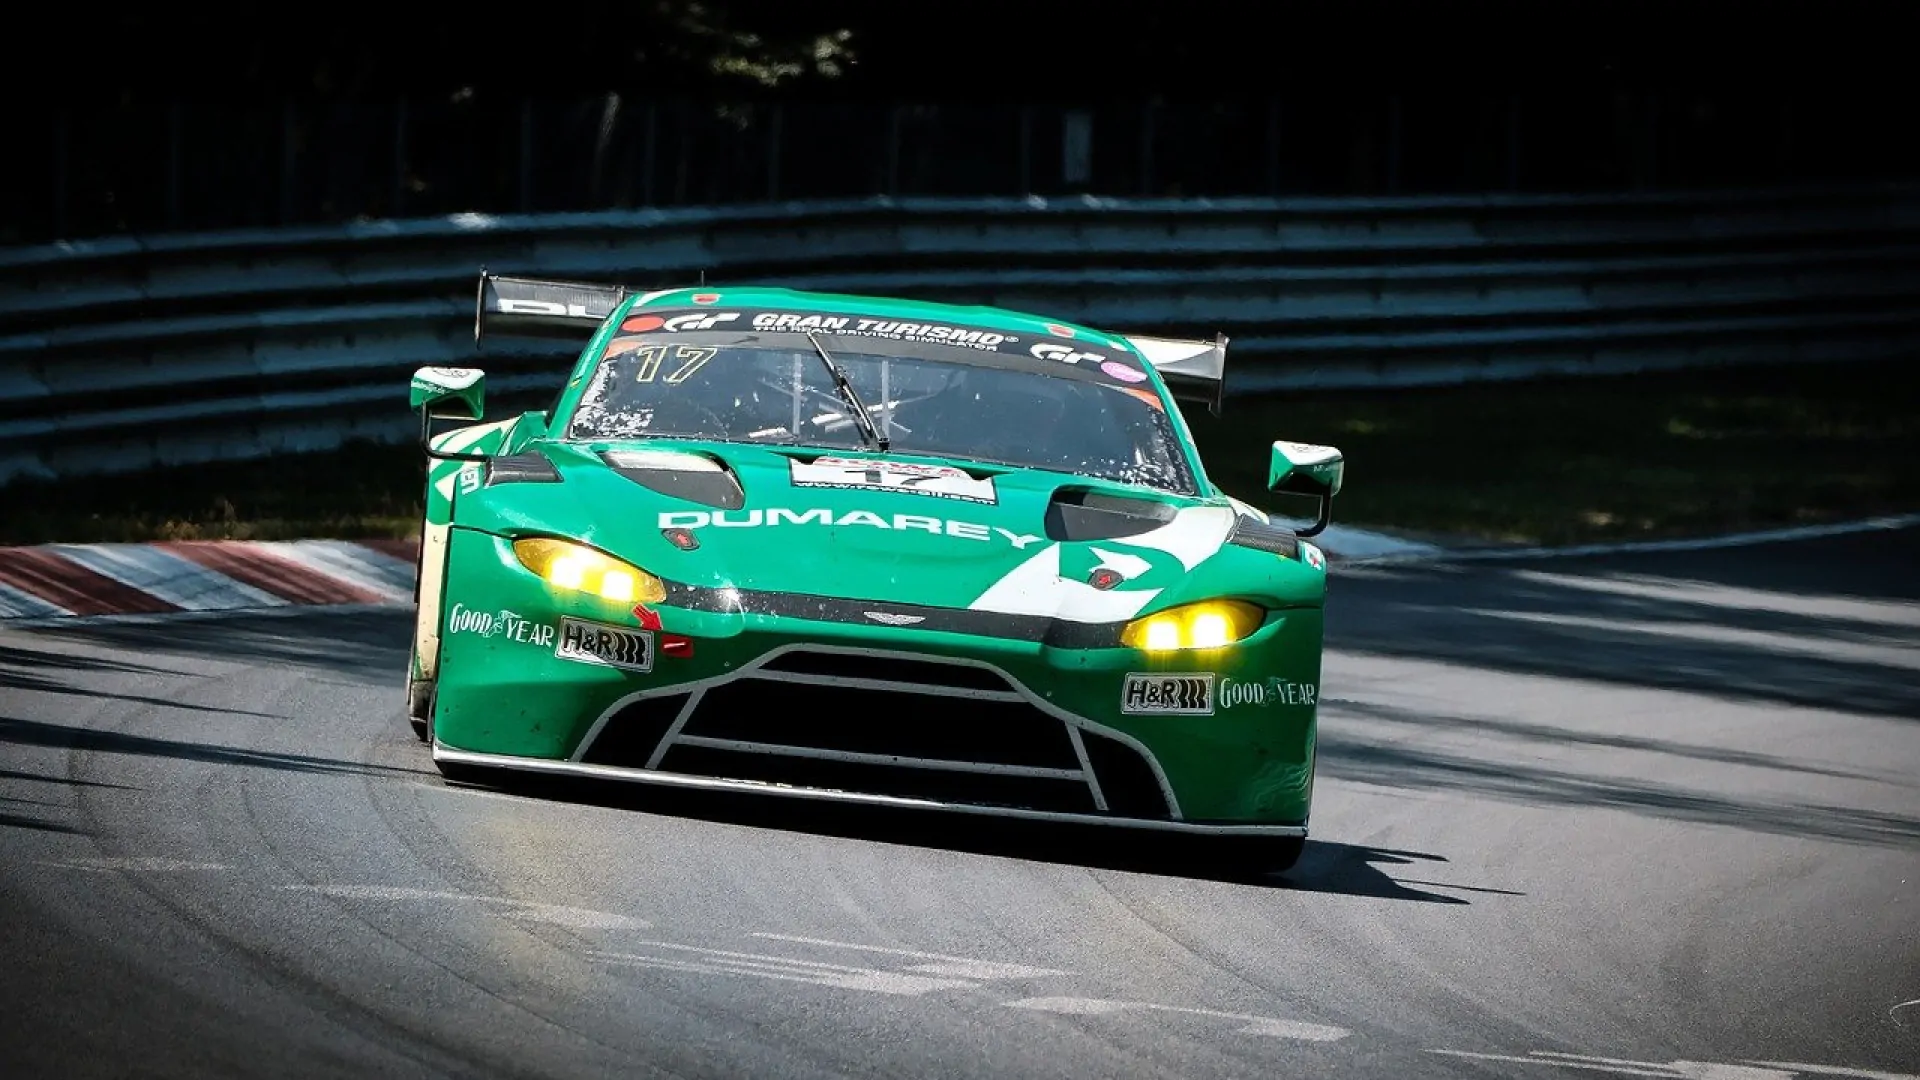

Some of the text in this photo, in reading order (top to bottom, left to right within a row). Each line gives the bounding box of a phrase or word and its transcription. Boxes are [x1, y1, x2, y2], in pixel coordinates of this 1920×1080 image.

[752, 312, 850, 330] GRAN
[836, 329, 901, 340] DRIVING
[904, 335, 998, 351] SIMULATOR
[635, 346, 718, 383] 17
[657, 507, 1044, 550] DUMAREY
[1127, 678, 1178, 708] H&R
